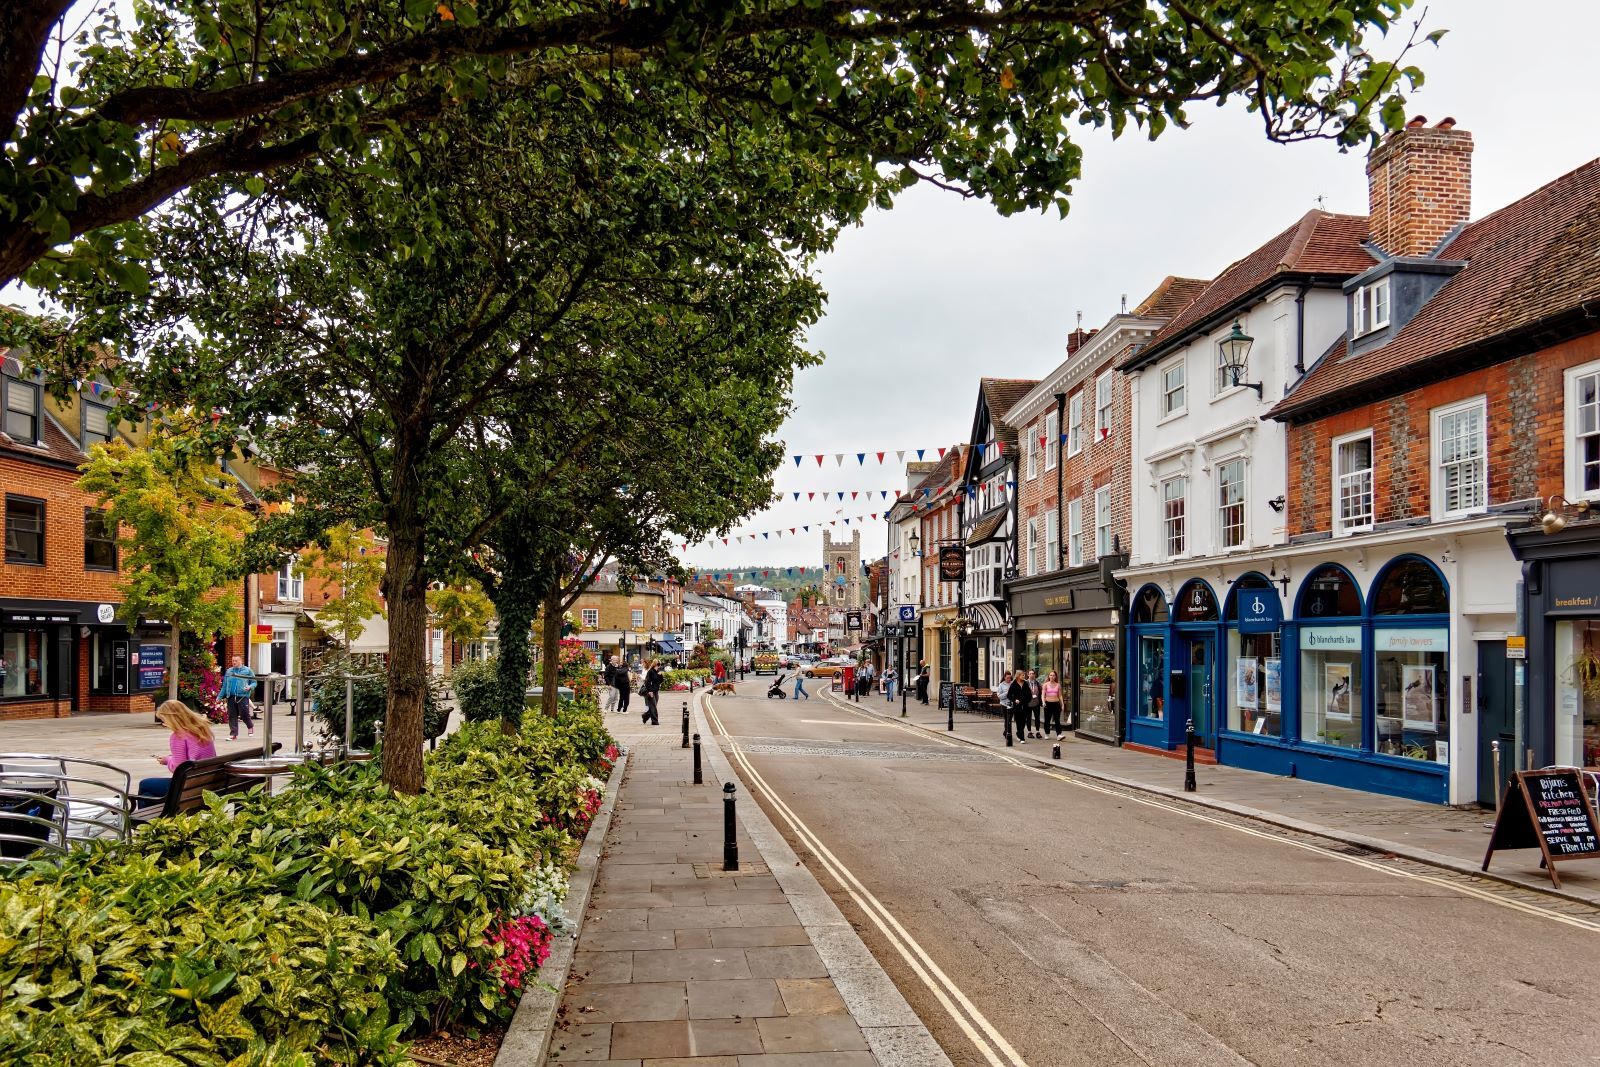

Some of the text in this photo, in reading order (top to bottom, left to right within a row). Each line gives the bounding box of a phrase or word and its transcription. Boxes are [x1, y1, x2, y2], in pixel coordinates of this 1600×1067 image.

[1555, 597, 1592, 607] breakfast
[1317, 635, 1355, 644] blanchards law
[1389, 636, 1433, 648] family lawyers
[1541, 789, 1574, 800] Kitchen
[1547, 808, 1567, 816] FRESH
